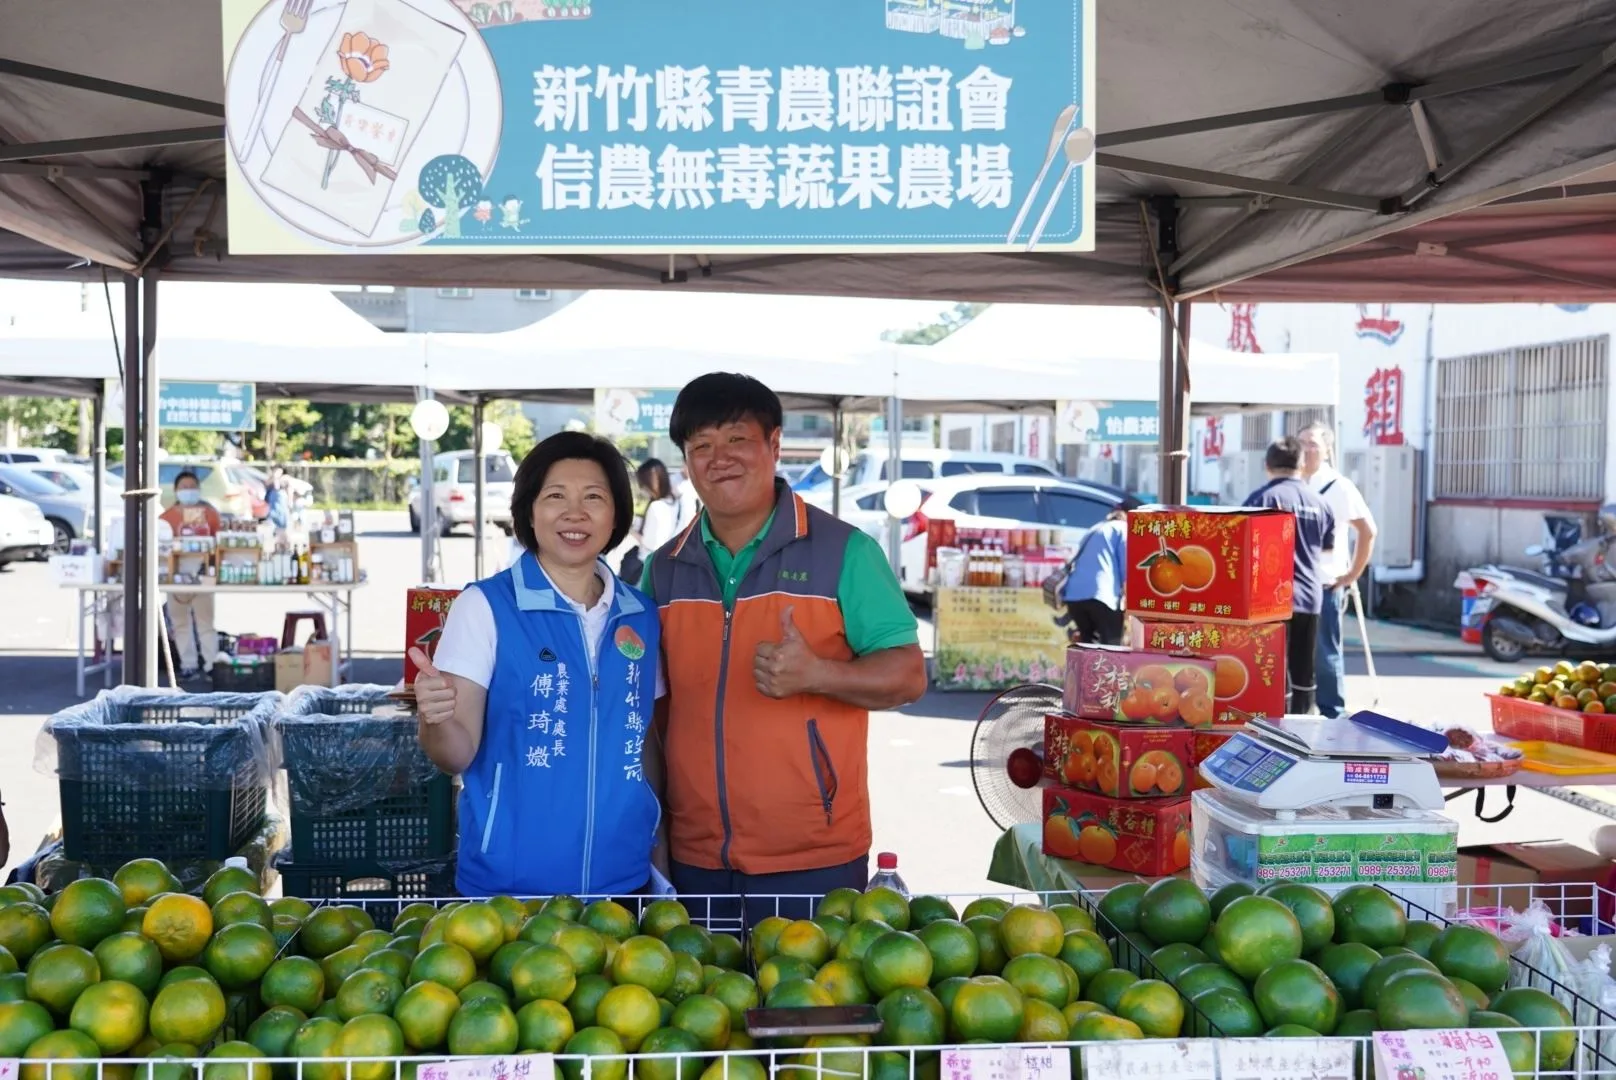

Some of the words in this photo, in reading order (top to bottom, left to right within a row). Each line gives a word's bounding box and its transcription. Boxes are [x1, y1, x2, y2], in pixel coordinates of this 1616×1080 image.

[534, 66, 1013, 133] 新竹縣青農聯誼會
[537, 143, 1014, 212] 信農無毒蔬果農場
[623, 661, 645, 782] 新竹縣政府
[1359, 865, 1420, 876] 0989-253271
